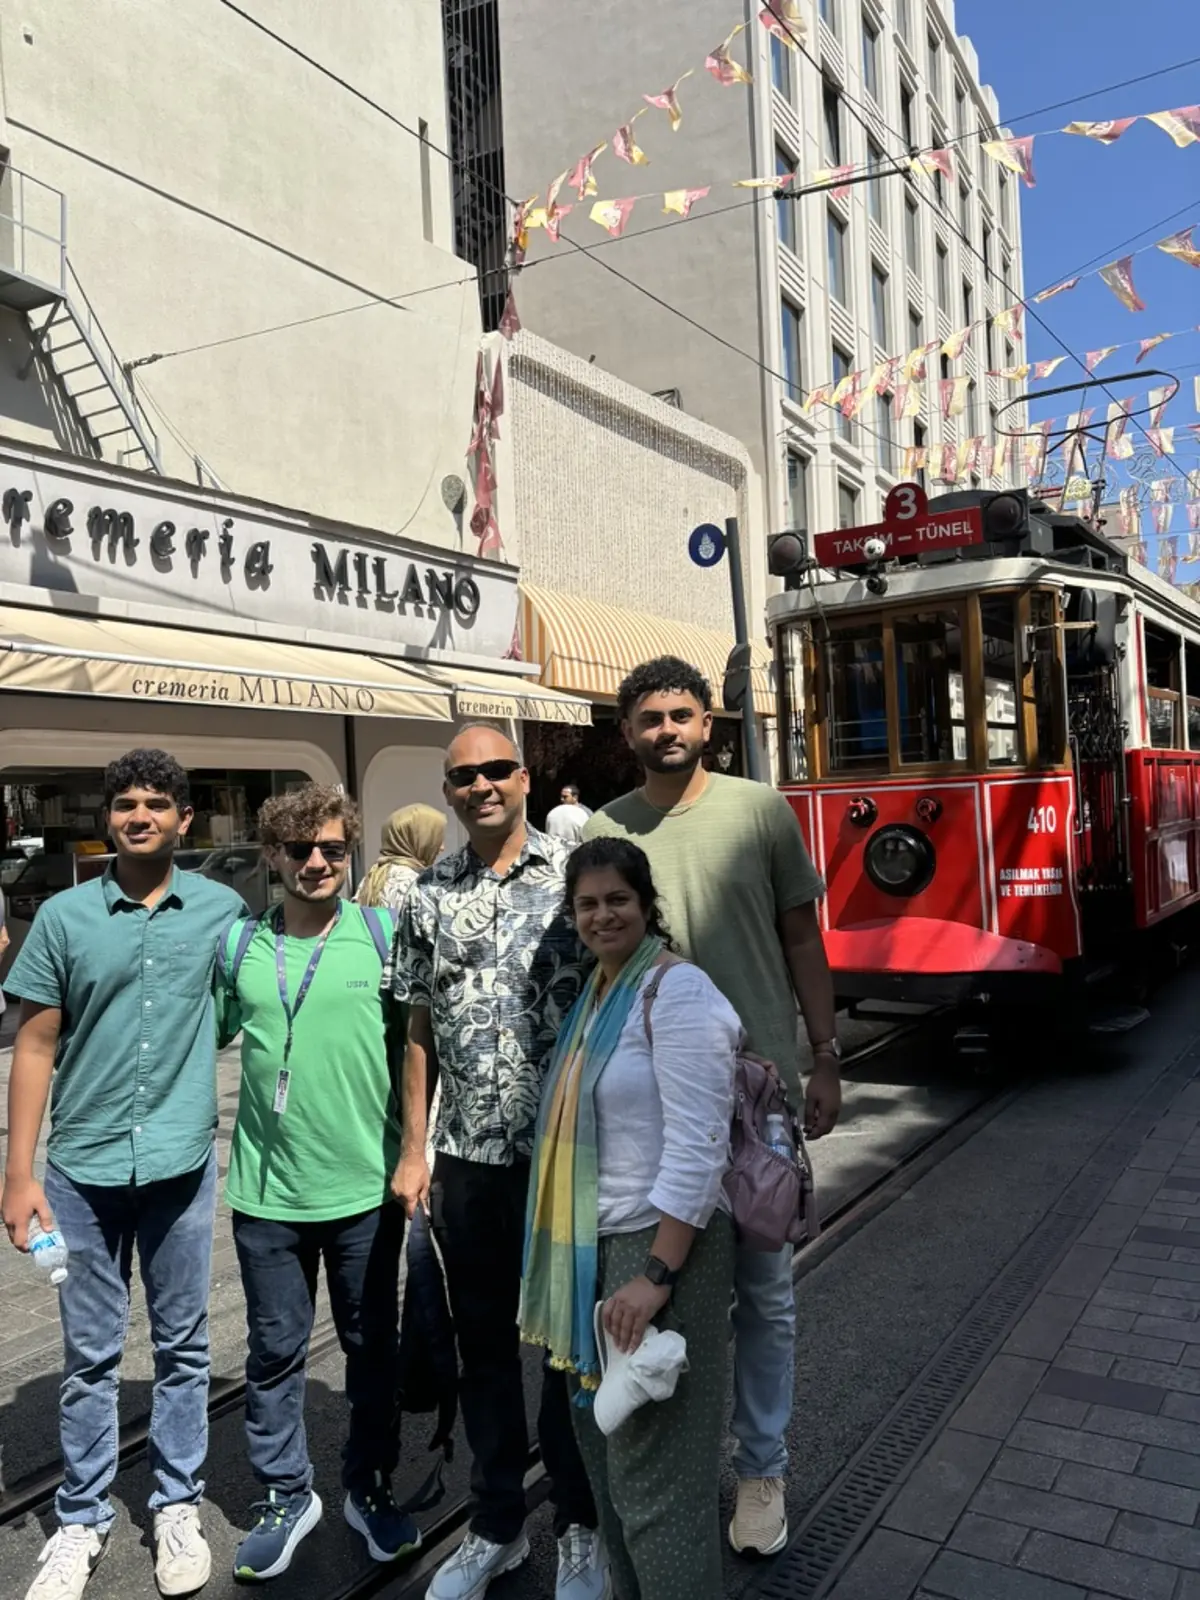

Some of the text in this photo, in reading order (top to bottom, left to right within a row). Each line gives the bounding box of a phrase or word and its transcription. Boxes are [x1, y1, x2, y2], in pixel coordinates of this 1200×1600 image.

[893, 486, 918, 520] 3
[833, 532, 894, 554] TAKM
[916, 521, 973, 541] TÜNEL
[310, 542, 480, 615] MILANO
[132, 676, 375, 712] cremeria MILANO
[458, 698, 590, 724] cremeria MILANO
[1027, 805, 1057, 834] 410
